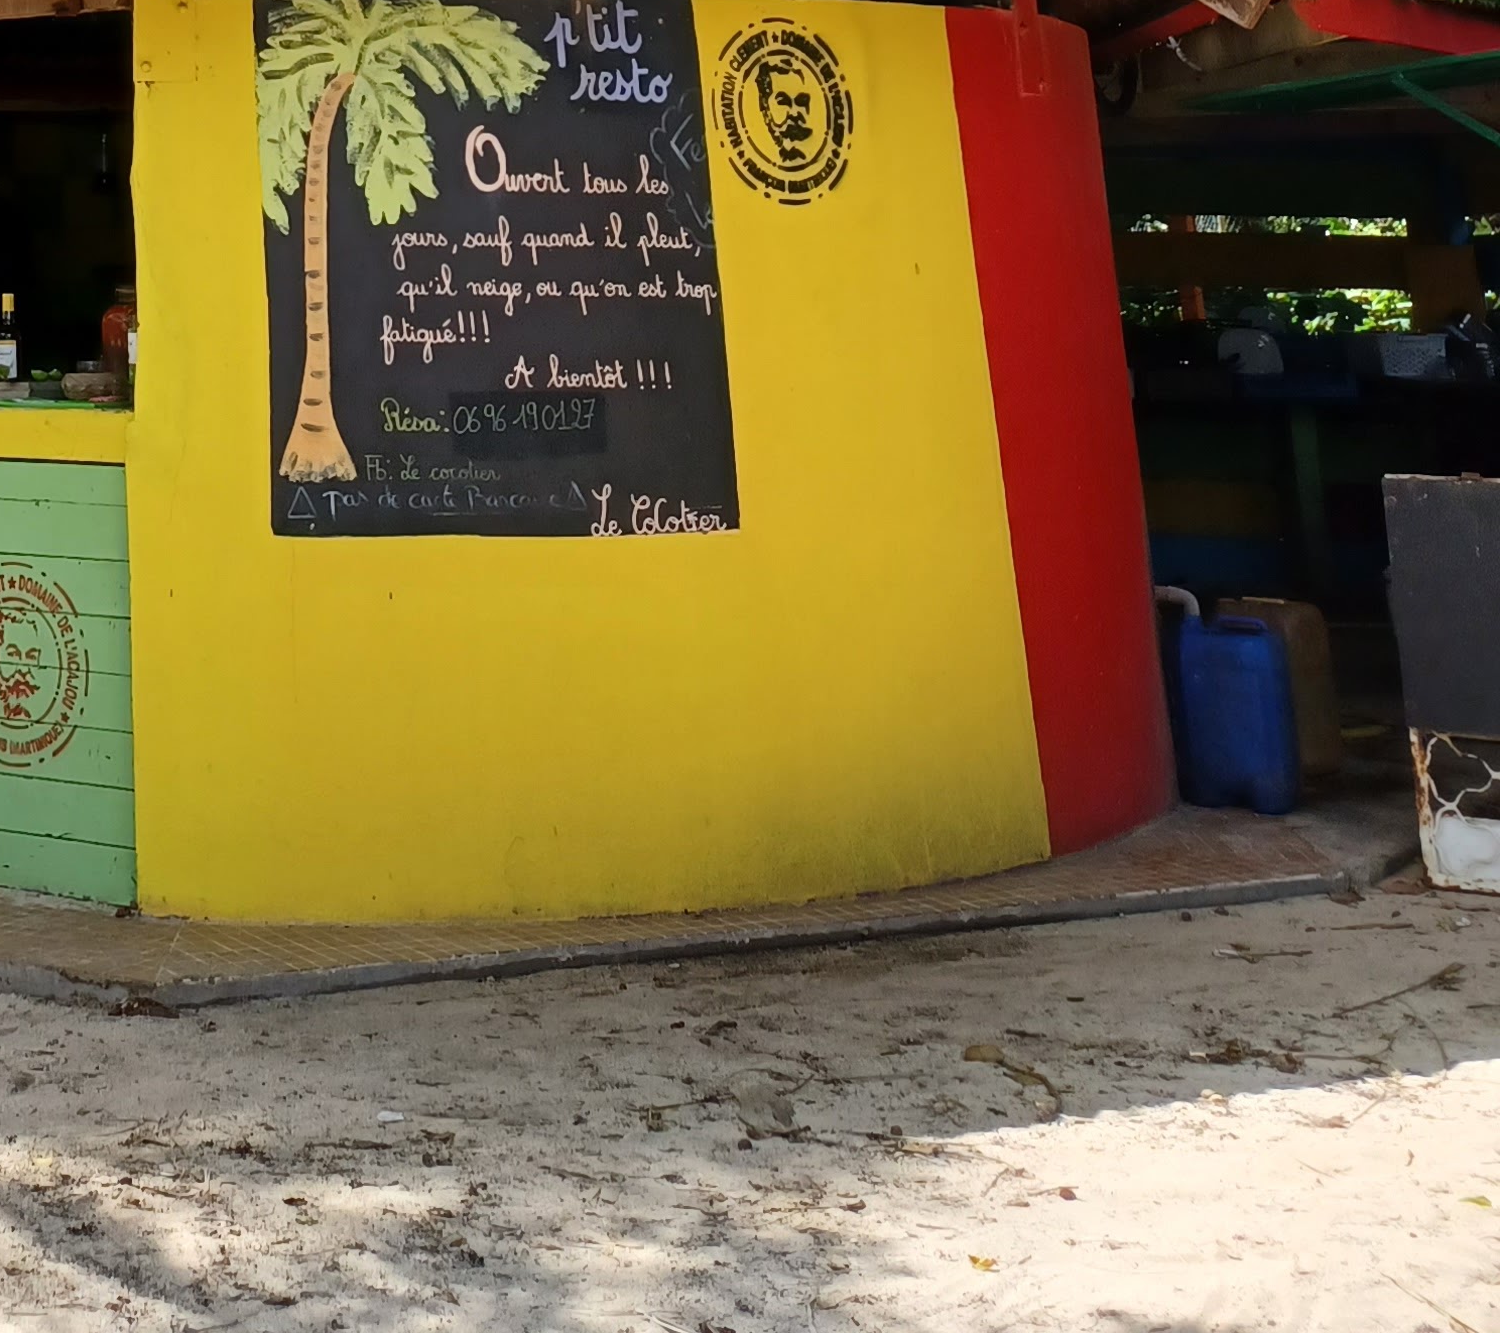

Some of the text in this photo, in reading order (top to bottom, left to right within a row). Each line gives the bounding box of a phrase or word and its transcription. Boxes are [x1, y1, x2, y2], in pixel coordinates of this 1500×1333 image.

[570, 58, 674, 104] resto
[465, 125, 670, 195] Ouvert tous les
[391, 212, 701, 271] jours, sauf quand il pleut,
[396, 263, 718, 316] qu'il neige, ou qu'on est trop
[504, 355, 535, 390] A
[547, 353, 628, 389] bientôt
[400, 453, 421, 481] Le
[590, 483, 623, 536] Le
[18, 574, 64, 619] DOMAINE
[56, 615, 75, 638] DE
